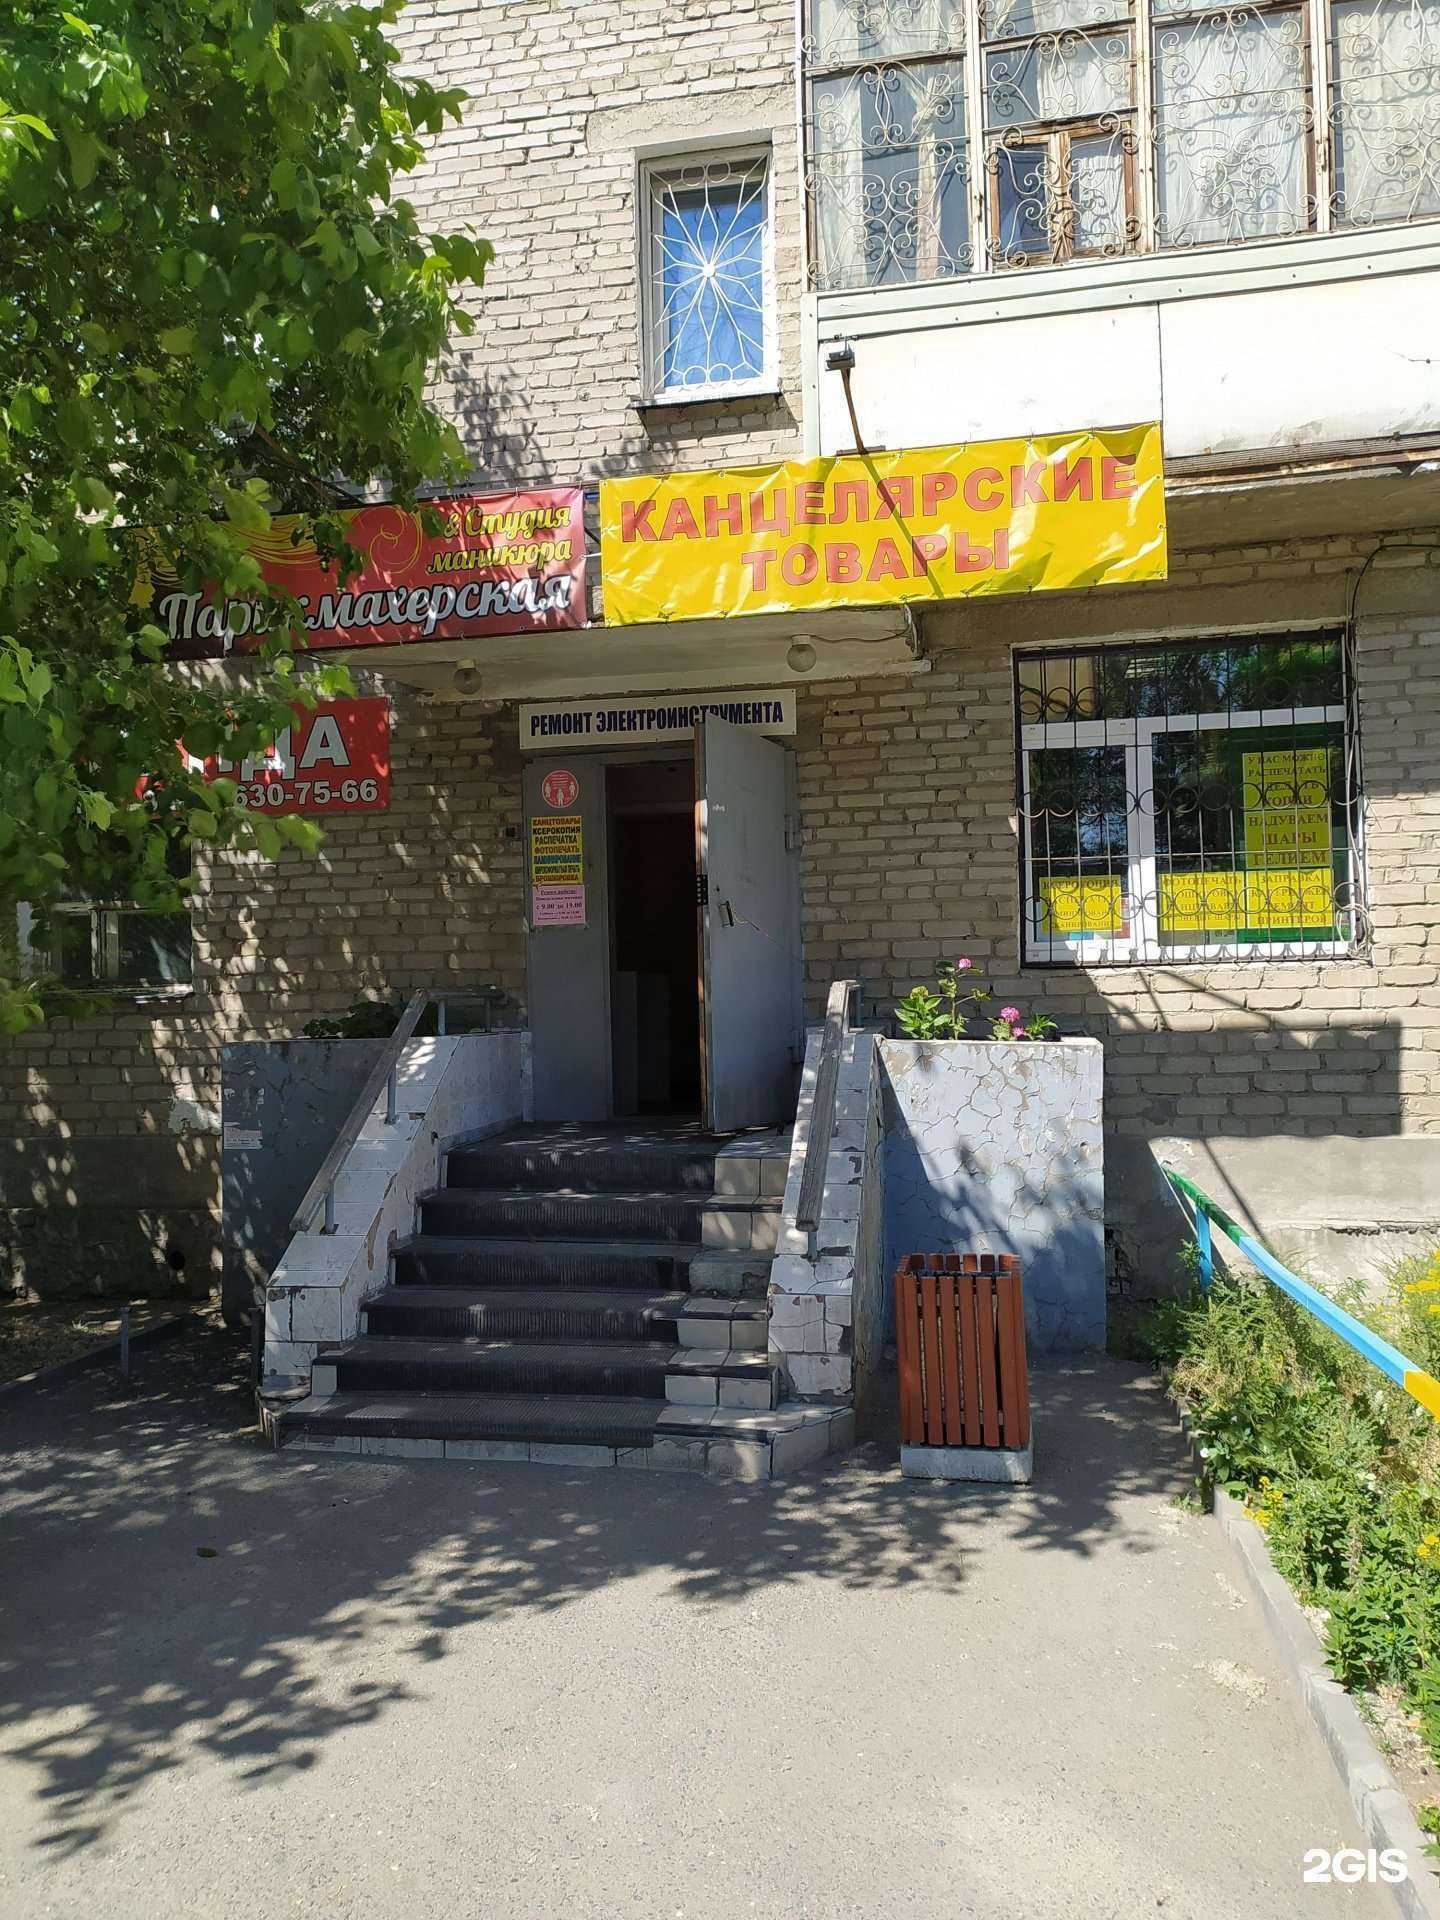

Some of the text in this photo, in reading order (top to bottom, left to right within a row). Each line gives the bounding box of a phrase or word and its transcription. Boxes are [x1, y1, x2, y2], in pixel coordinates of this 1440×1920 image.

[621, 454, 1137, 544] КАНЦЕЛЯРСКИЕ
[464, 505, 571, 542] Студия
[425, 539, 572, 575] маникюра
[741, 528, 1010, 592] ТОВАРЫ
[530, 711, 593, 736] РЕМОНТ
[1248, 813, 1329, 827] НАДУВАЕМ
[532, 826, 581, 835] КСЕРОКОПИЯ
[534, 835, 578, 845] РАСПЕЧАТКА
[534, 845, 580, 854] ФОТОПЕЧАТЬ
[1253, 851, 1328, 866] ГЕЛИЕМ
[1041, 879, 1119, 889] КЕРООПИЯ
[1163, 876, 1242, 887] ФОТОЕЧАТЬ
